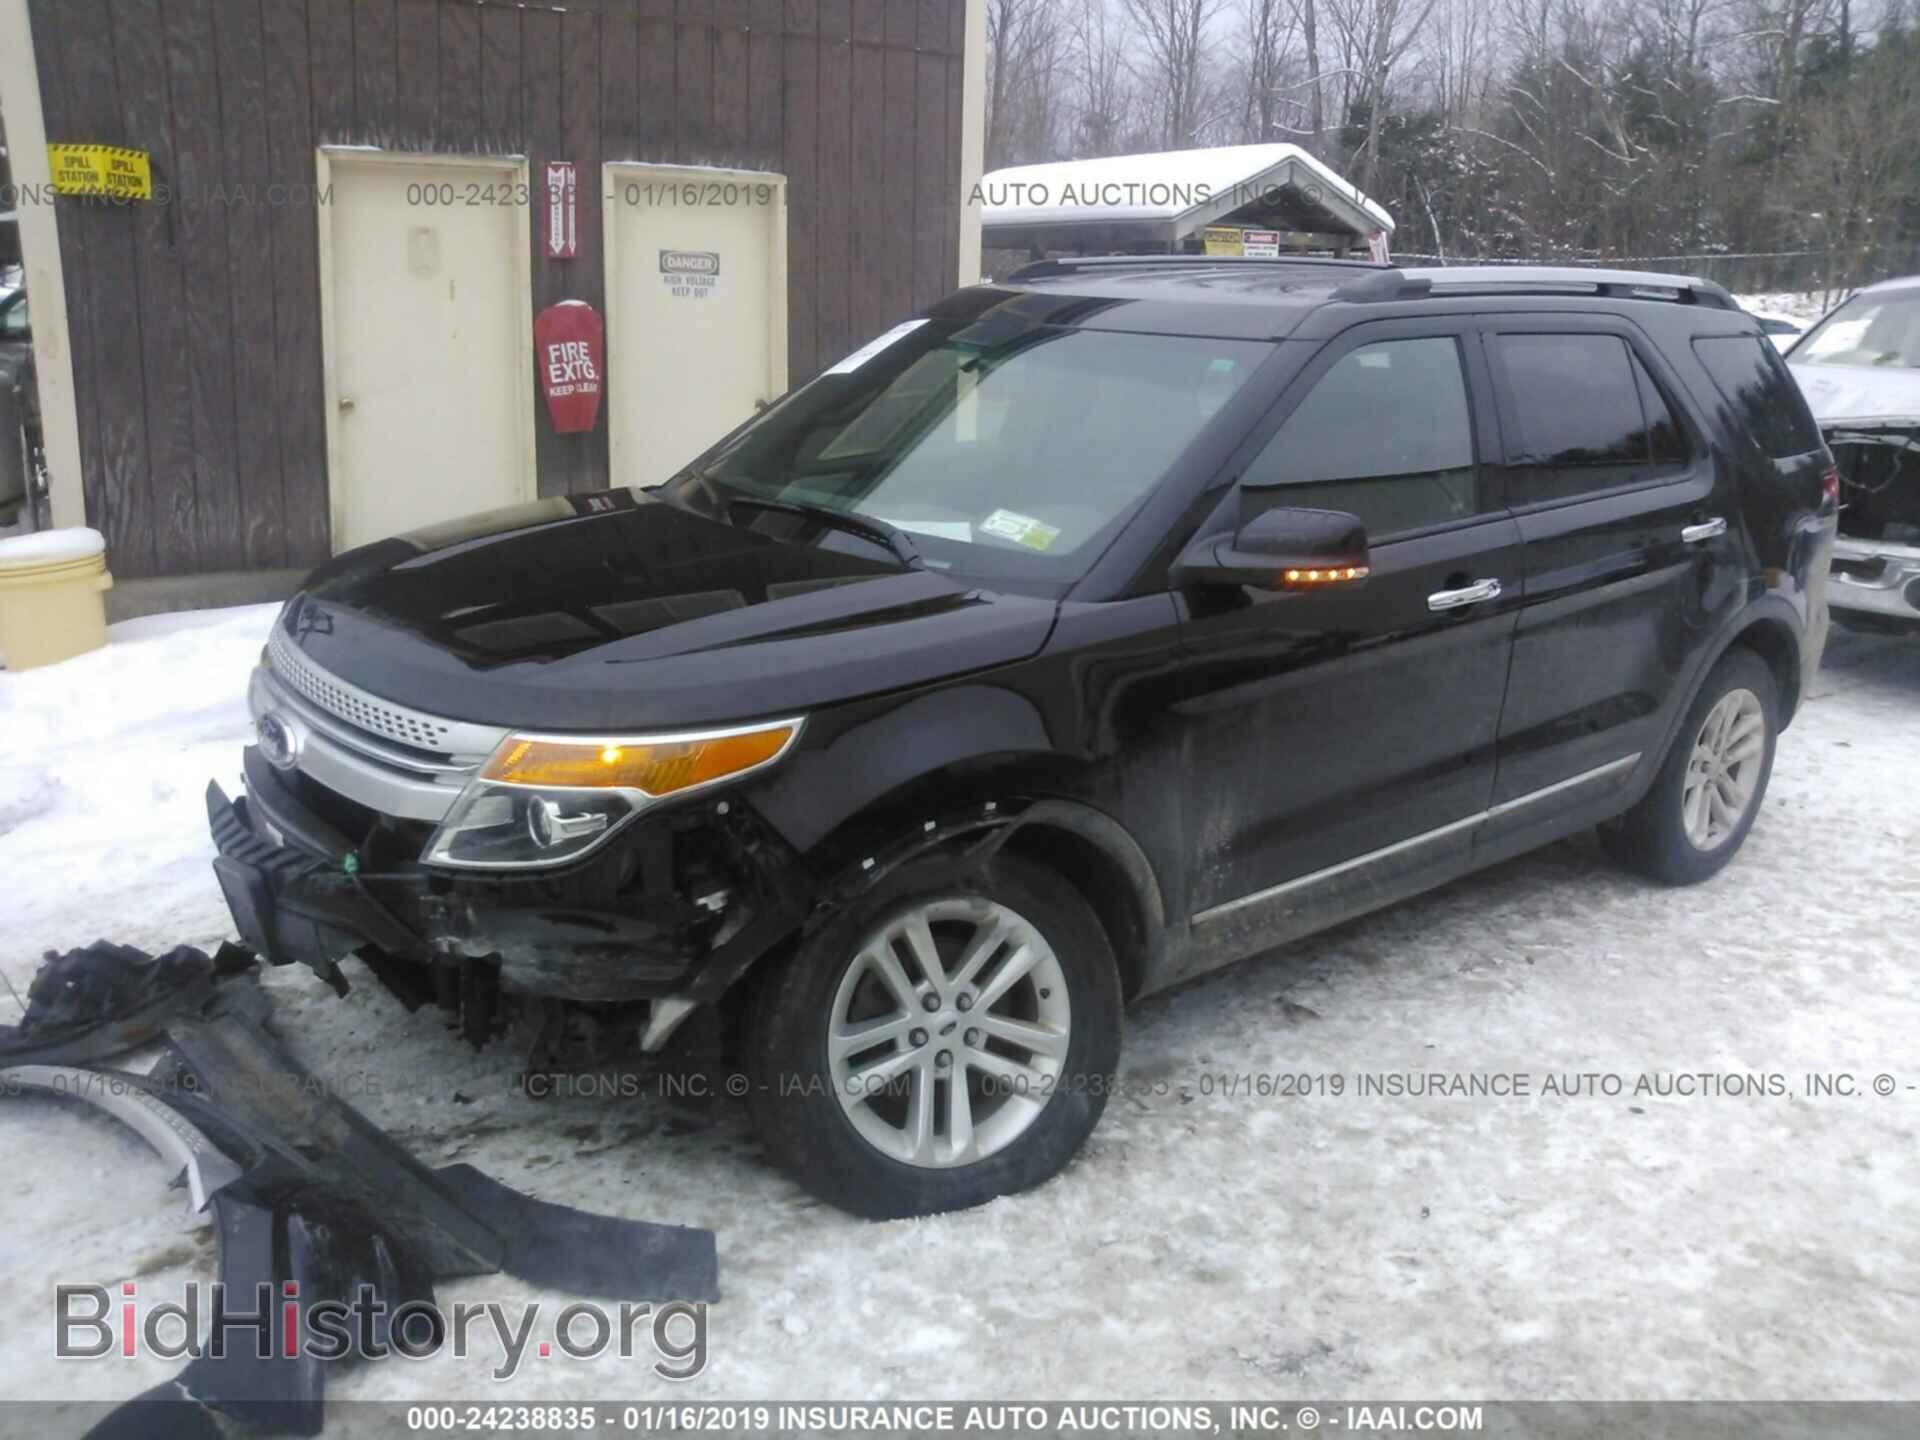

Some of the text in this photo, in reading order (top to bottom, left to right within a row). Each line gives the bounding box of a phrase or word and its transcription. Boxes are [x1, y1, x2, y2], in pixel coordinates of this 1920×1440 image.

[64, 156, 92, 169] SPILL
[111, 159, 136, 173] SPILL
[58, 170, 99, 183] STATION
[106, 173, 144, 187] STATION
[666, 255, 713, 270] DANGER
[548, 342, 590, 363] FIRE
[550, 384, 575, 396] KEEP
